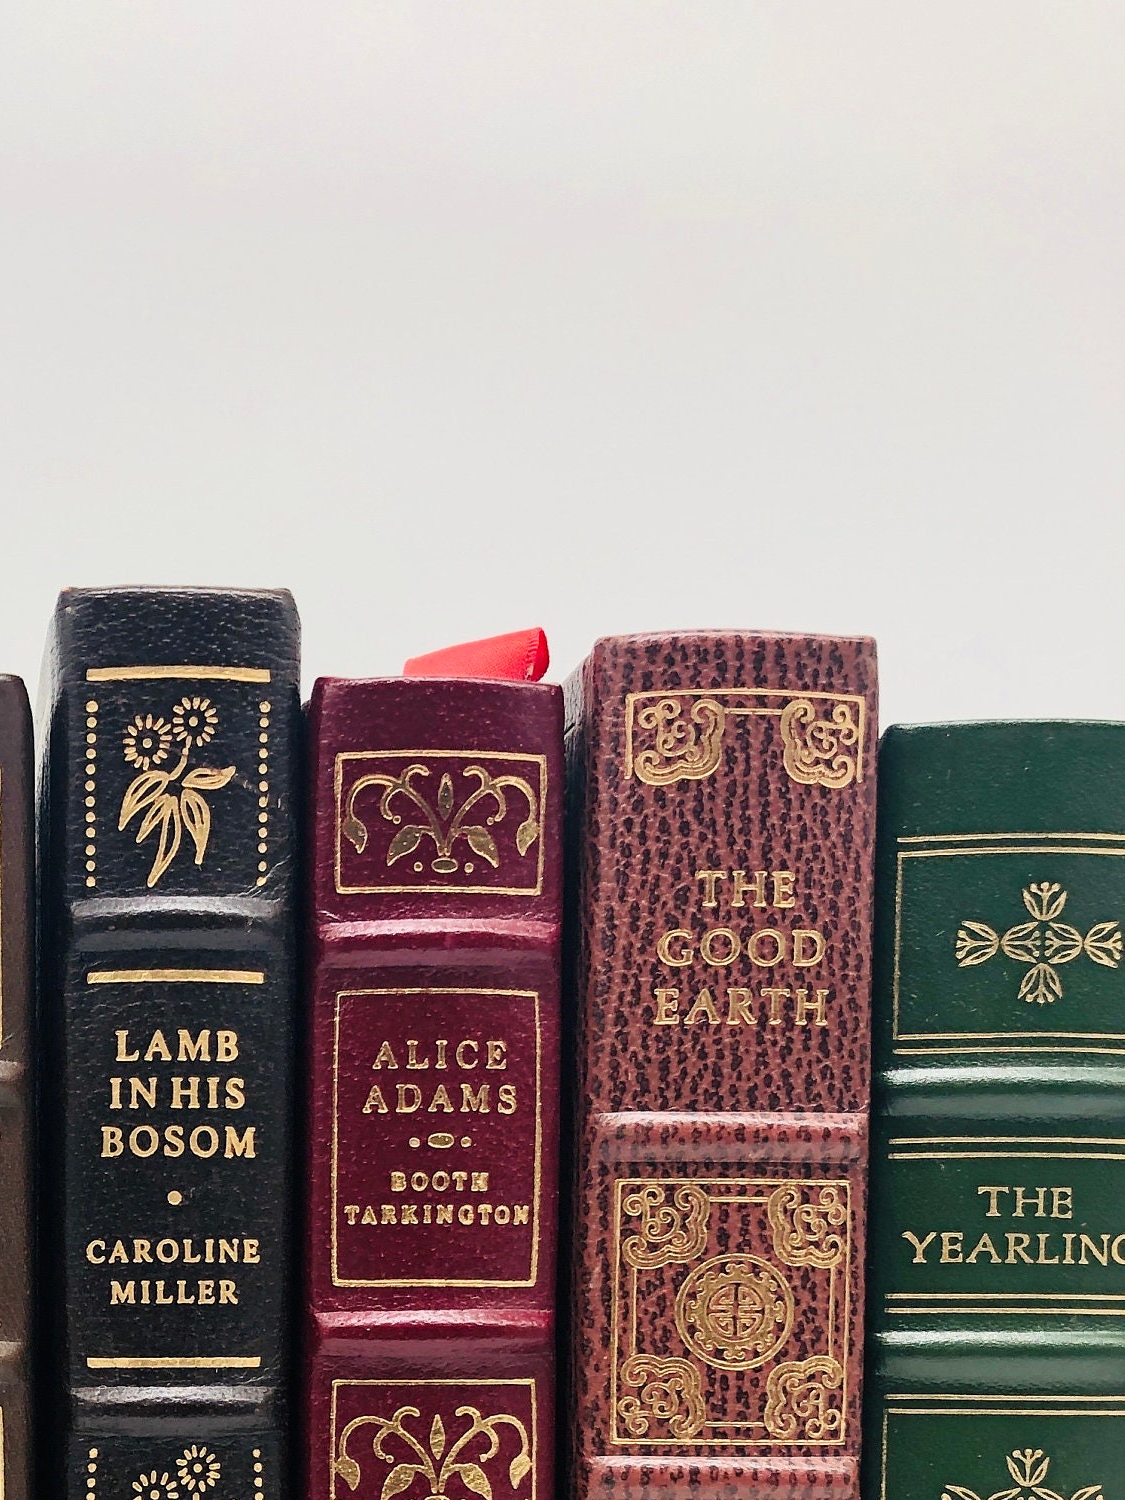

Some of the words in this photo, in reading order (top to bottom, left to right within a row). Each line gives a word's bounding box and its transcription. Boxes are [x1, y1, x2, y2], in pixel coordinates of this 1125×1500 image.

[694, 869, 797, 910] THE
[656, 927, 827, 968] GOOD
[652, 986, 830, 1027] EARTH
[114, 1029, 239, 1063] LAMB
[371, 1039, 507, 1070] ALICE
[109, 1076, 158, 1110] IN
[169, 1076, 246, 1110] HIS
[361, 1083, 518, 1115] ADAMS
[100, 1124, 256, 1159] BOSOM
[390, 1170, 490, 1192] BOOTH
[343, 1203, 531, 1227] TARKINGTON
[977, 1186, 1073, 1219] THE
[85, 1238, 261, 1265] CAROLINE
[109, 1279, 239, 1305] MILLER
